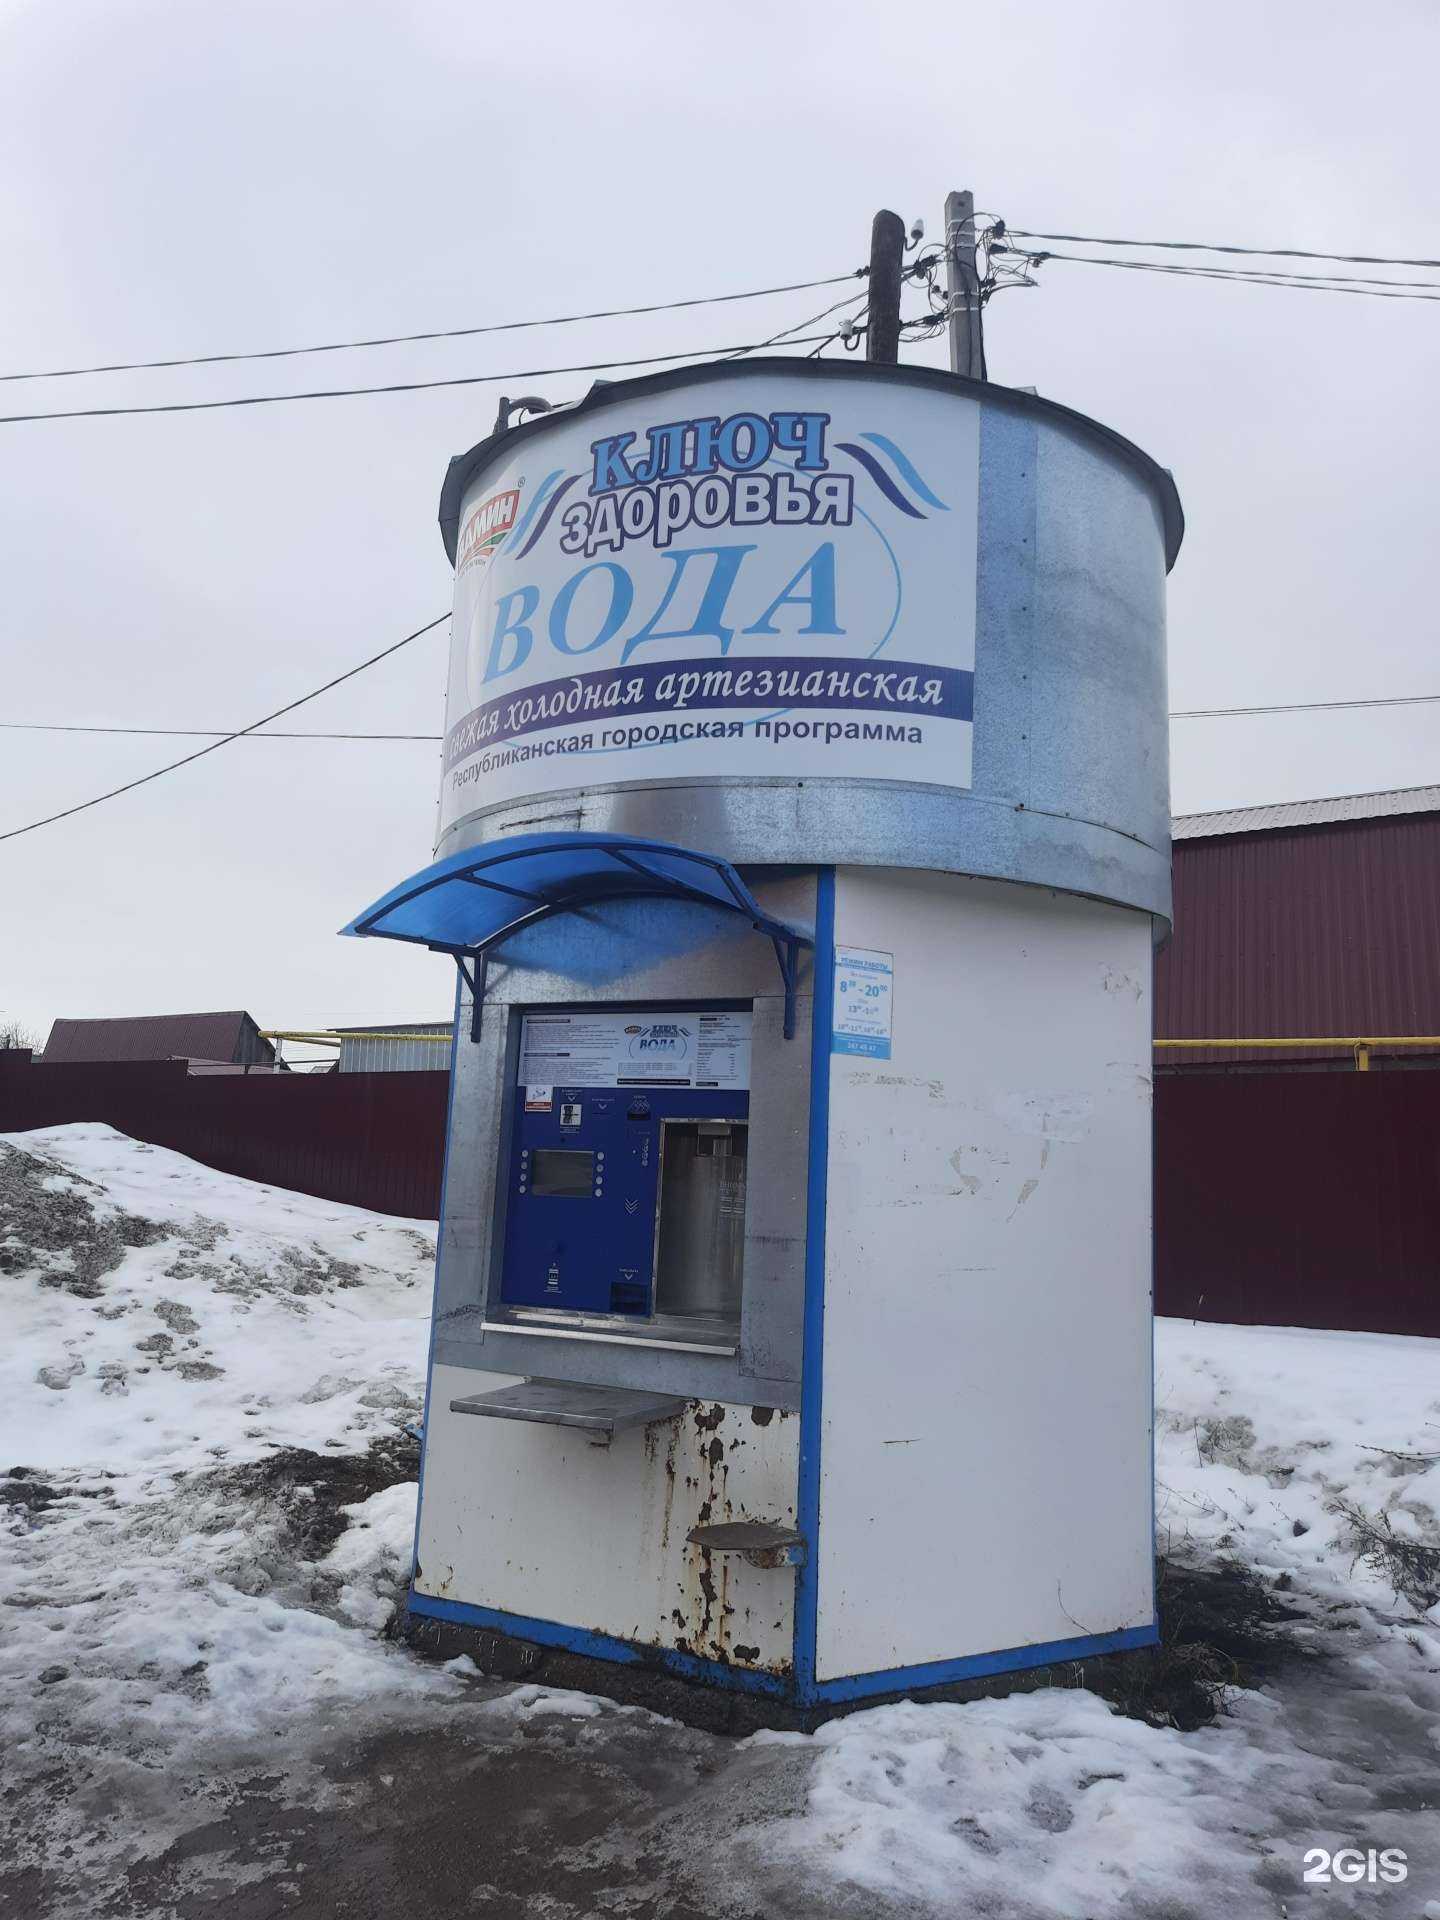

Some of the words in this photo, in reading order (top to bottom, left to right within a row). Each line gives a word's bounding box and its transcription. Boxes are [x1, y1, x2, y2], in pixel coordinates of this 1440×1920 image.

[589, 412, 830, 496] КЛЮЧ
[482, 541, 847, 685] ВОДА
[504, 678, 645, 732] холодная
[655, 669, 943, 708] артезианская
[453, 733, 593, 792] Республиканская
[602, 720, 744, 749] городская
[755, 720, 922, 744] программа
